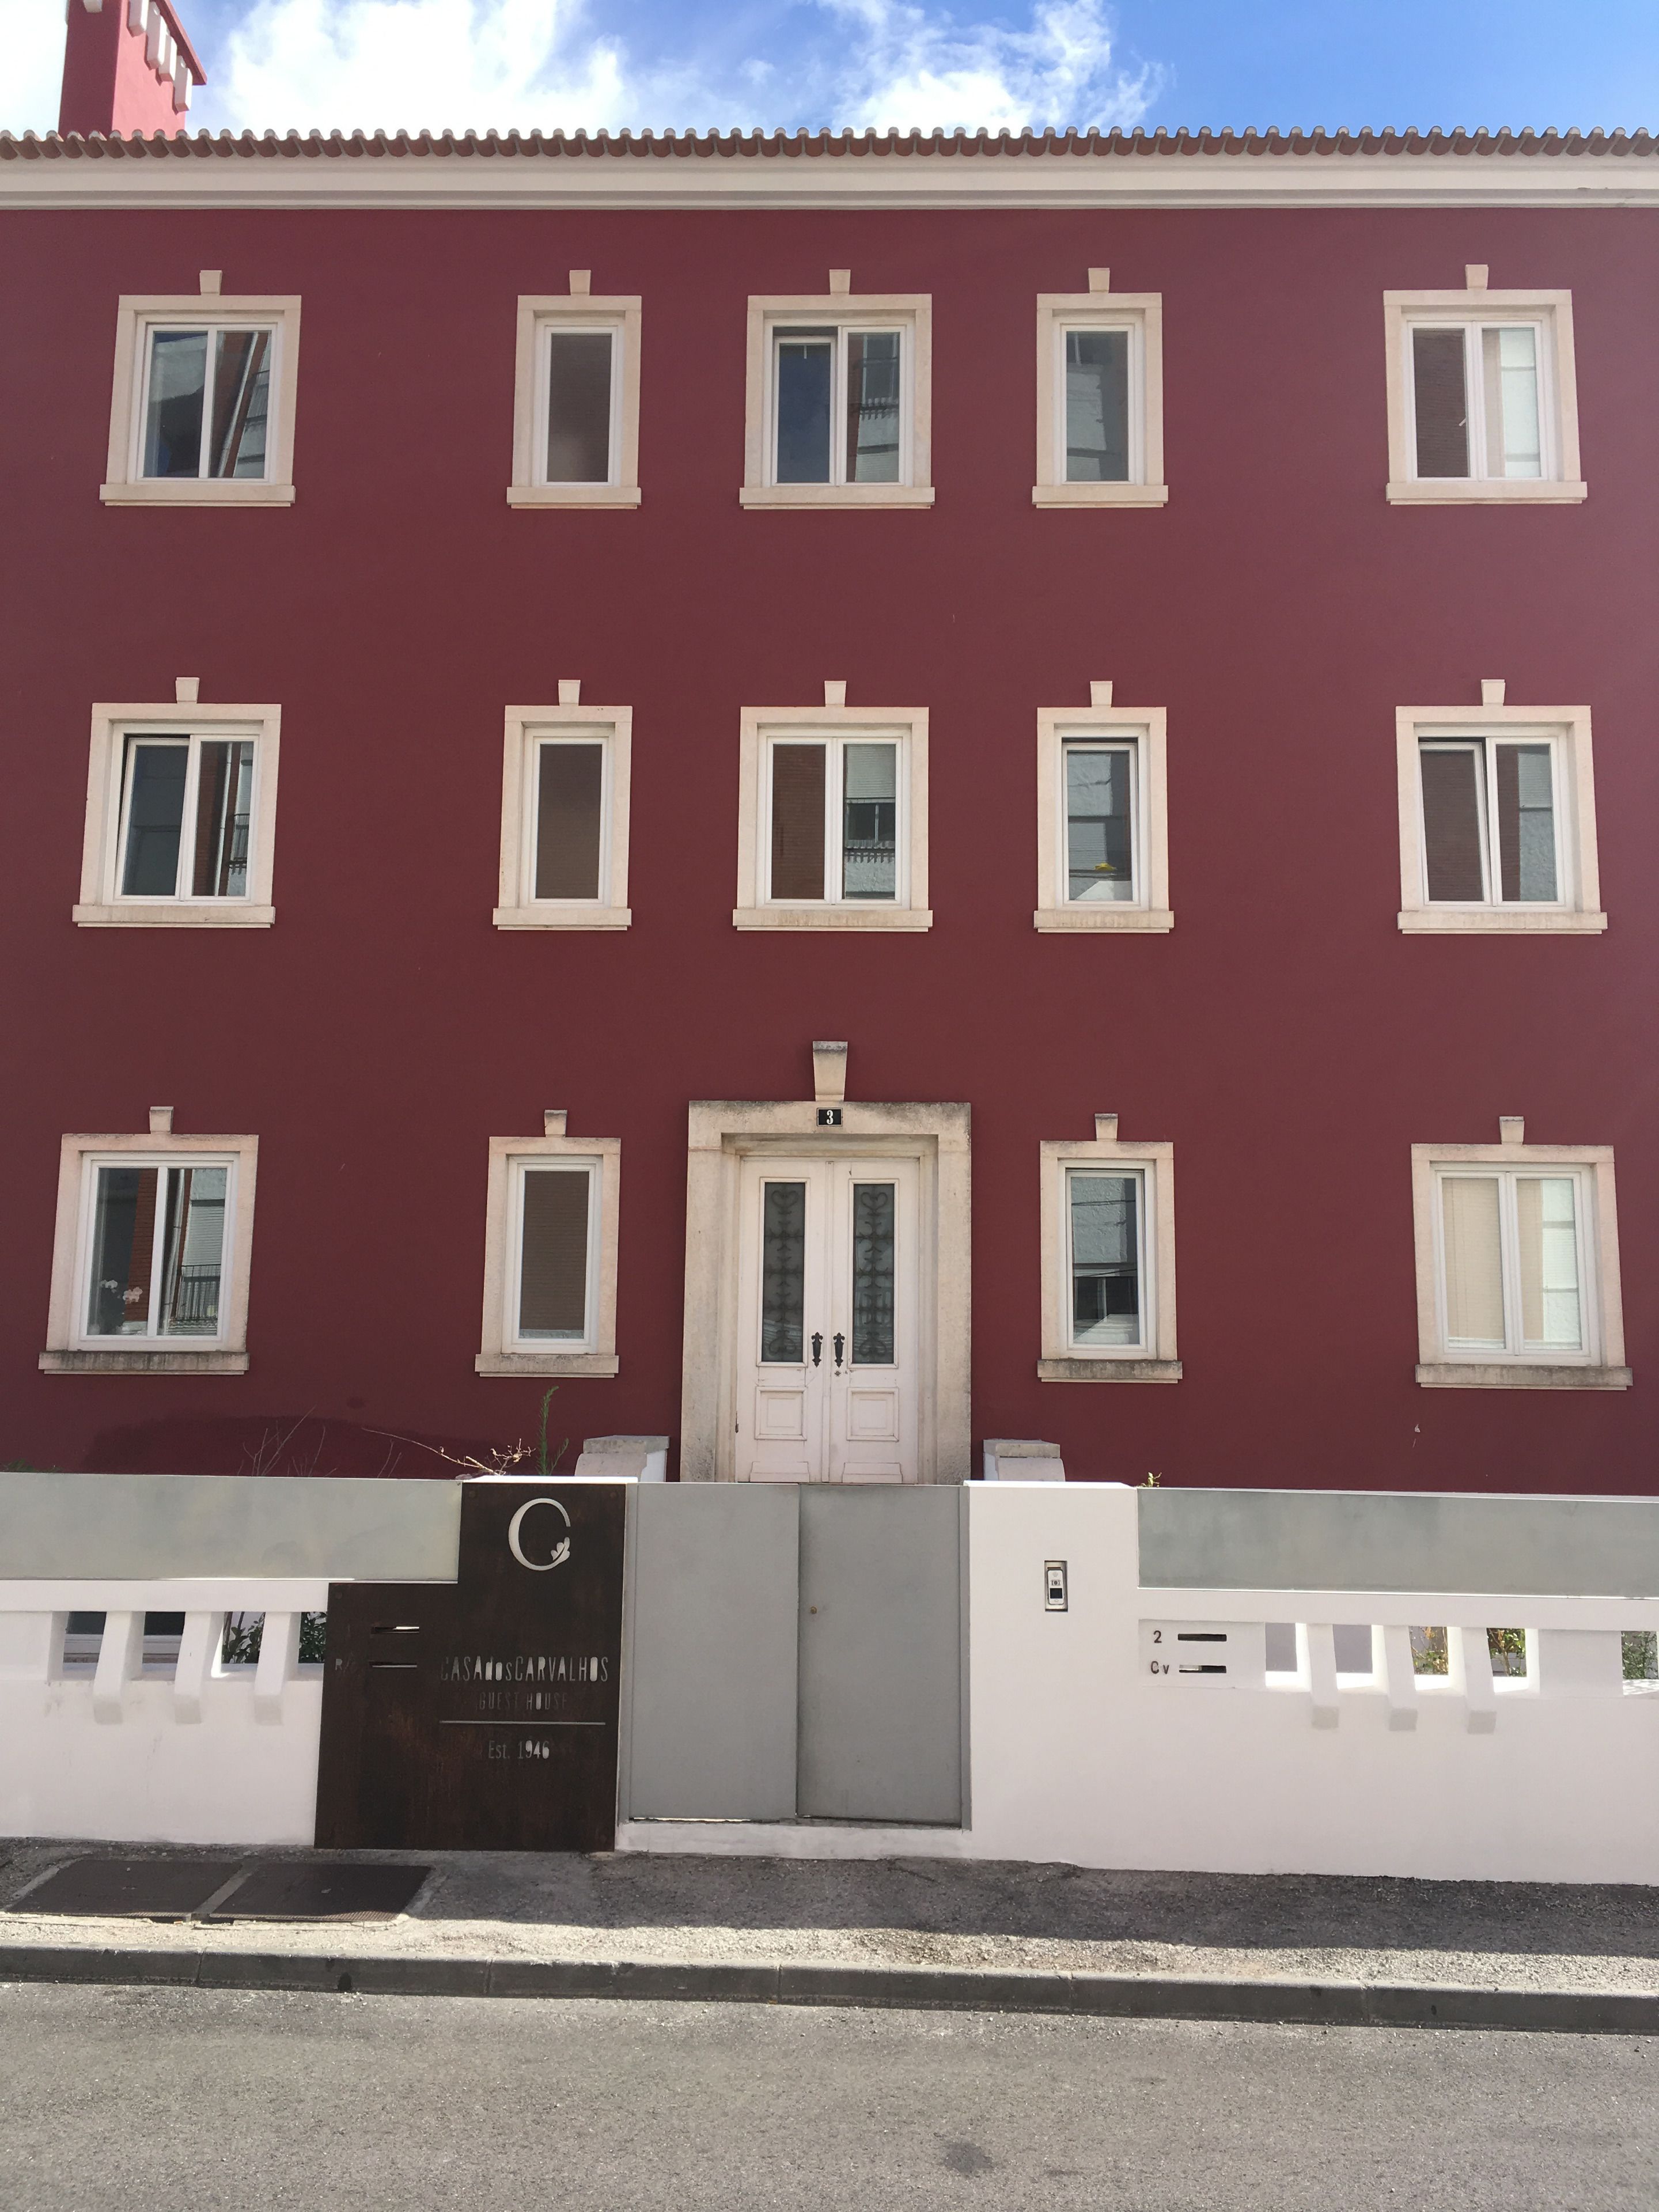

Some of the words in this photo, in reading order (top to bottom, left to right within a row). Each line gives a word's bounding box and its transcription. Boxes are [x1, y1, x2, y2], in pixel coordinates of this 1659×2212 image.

[826, 1109, 834, 1125] 3
[1153, 1630, 1162, 1643] 2
[479, 1691, 520, 1710] GUEST
[526, 1692, 567, 1710] HOUSE
[488, 1740, 511, 1760] Est.
[518, 1740, 550, 1760] 1946
